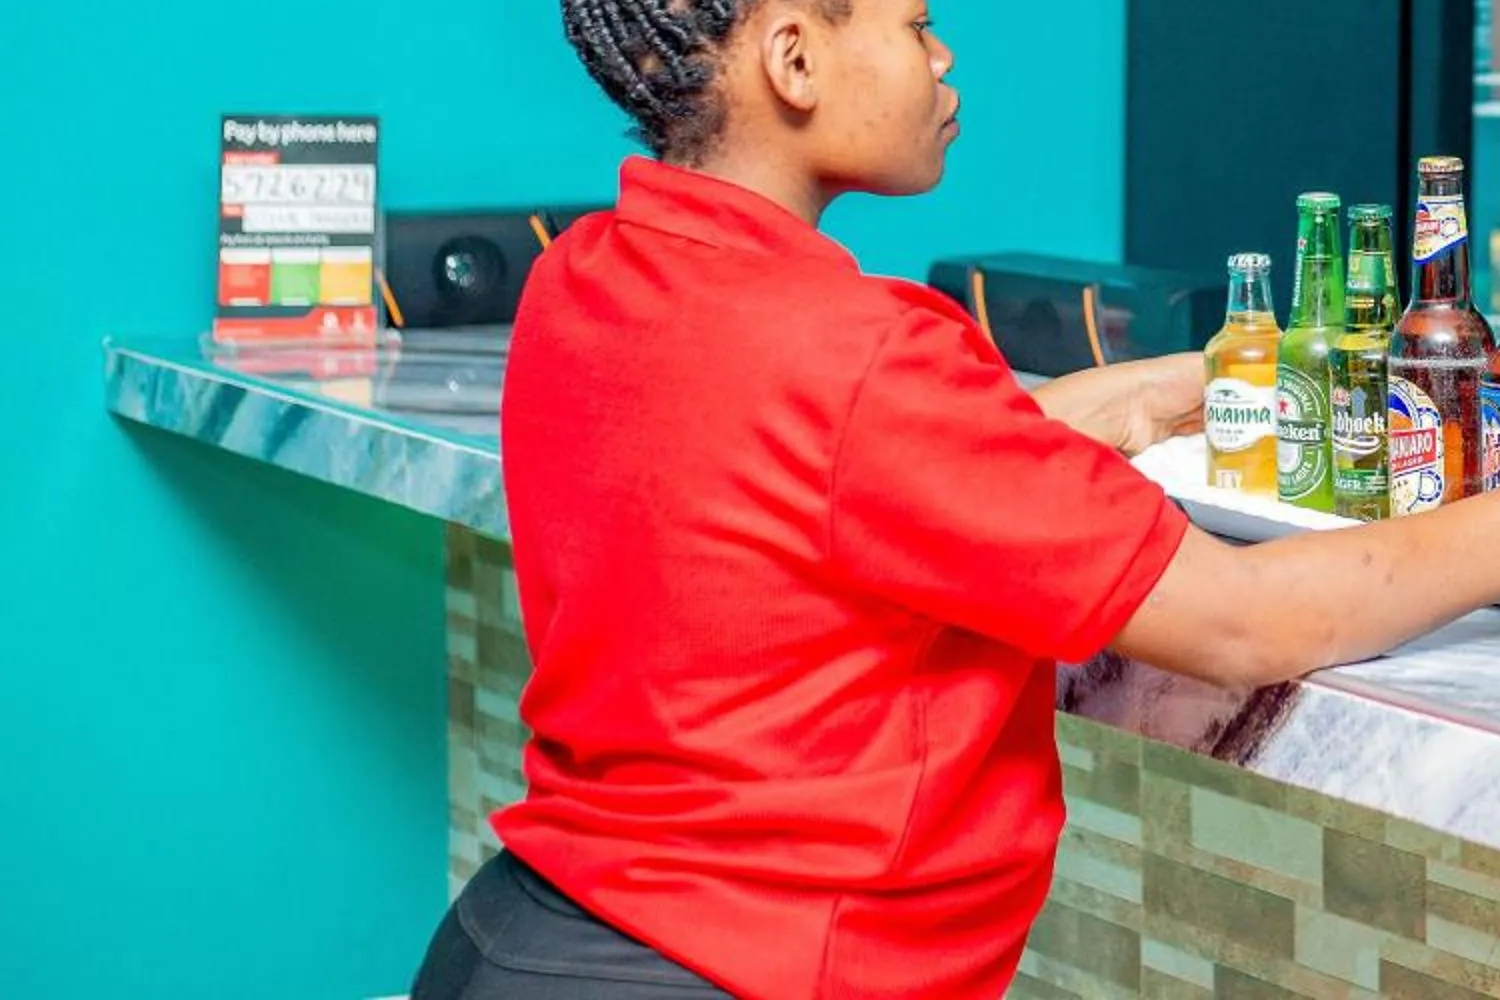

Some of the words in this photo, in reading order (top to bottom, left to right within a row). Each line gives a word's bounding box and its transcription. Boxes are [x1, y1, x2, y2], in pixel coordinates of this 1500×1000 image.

[223, 119, 257, 146] Pay
[257, 119, 281, 146] by
[281, 119, 336, 146] phone
[336, 119, 377, 143] here
[1206, 404, 1272, 425] avanna
[1333, 410, 1385, 434] dhoek
[1278, 422, 1323, 441] eken
